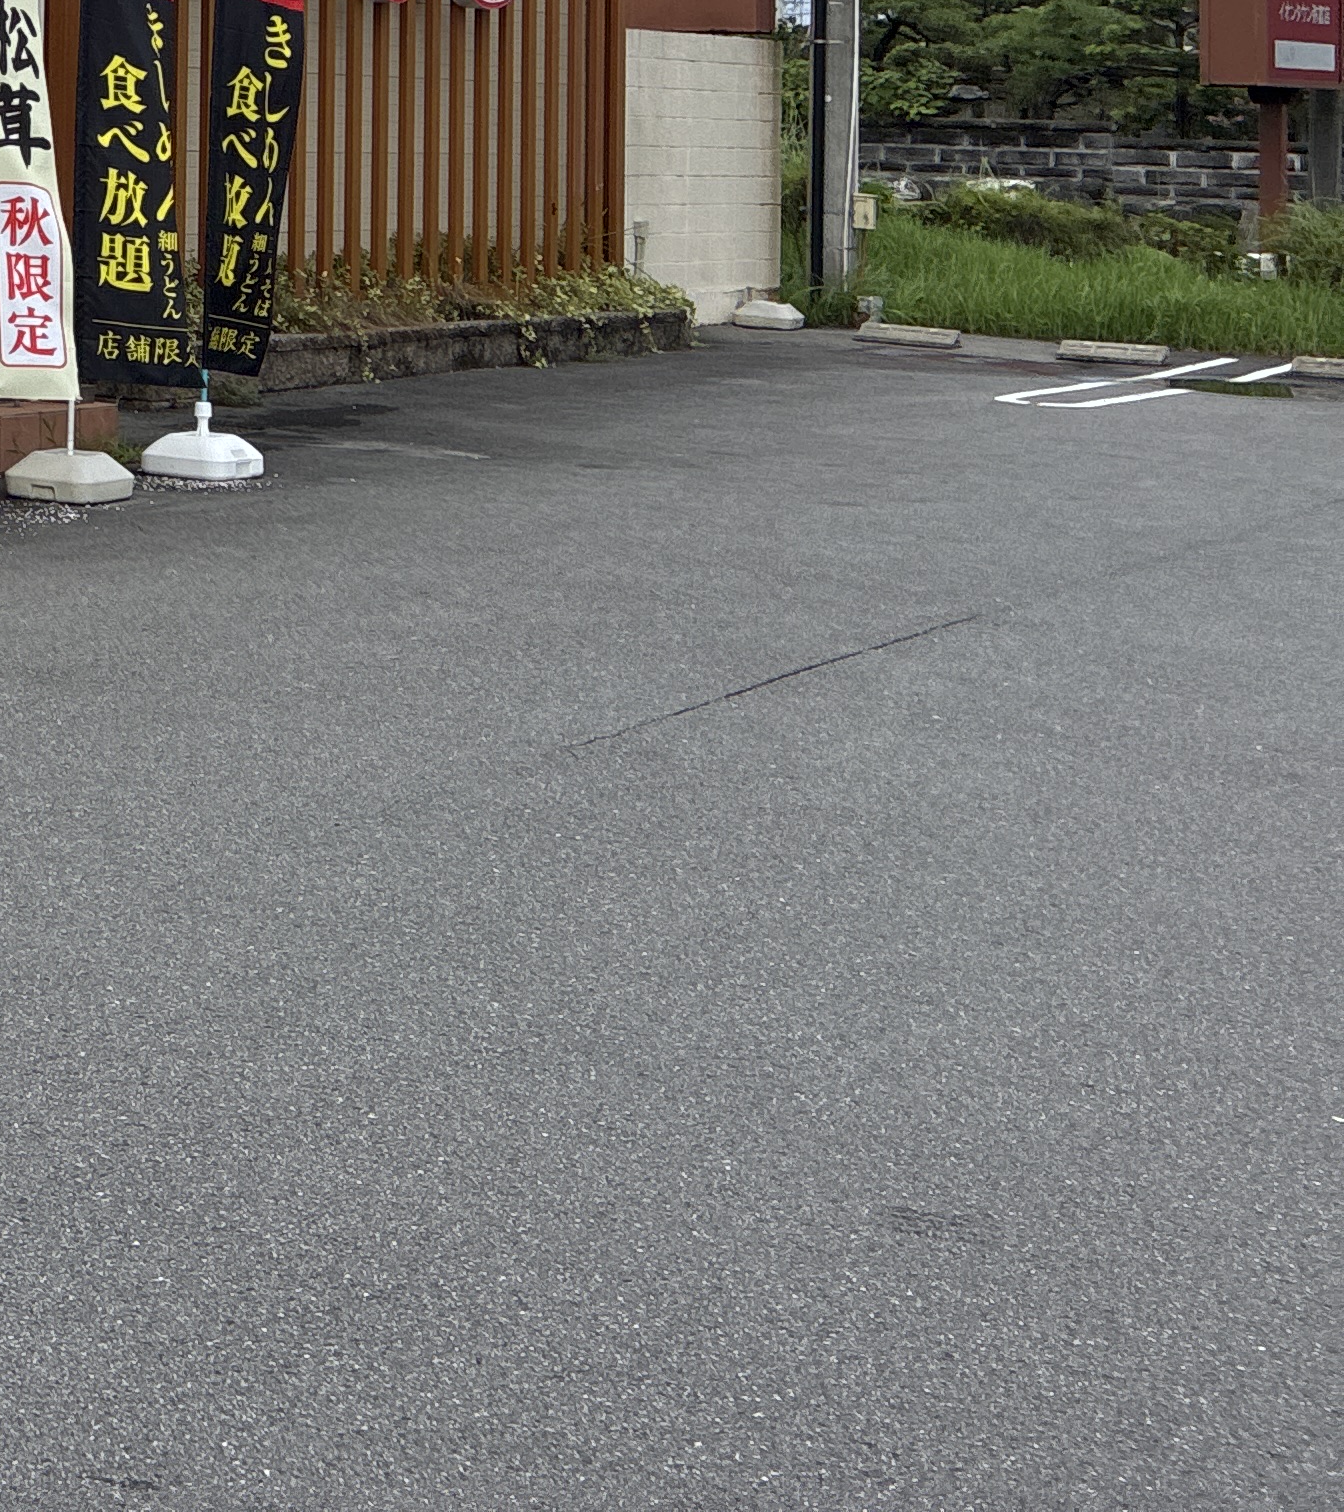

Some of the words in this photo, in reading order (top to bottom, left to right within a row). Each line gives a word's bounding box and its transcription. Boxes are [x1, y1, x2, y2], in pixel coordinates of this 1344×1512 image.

[97, 54, 154, 293] 食べ放題
[0, 195, 57, 357] 秋限定
[157, 229, 182, 320] 細うどん
